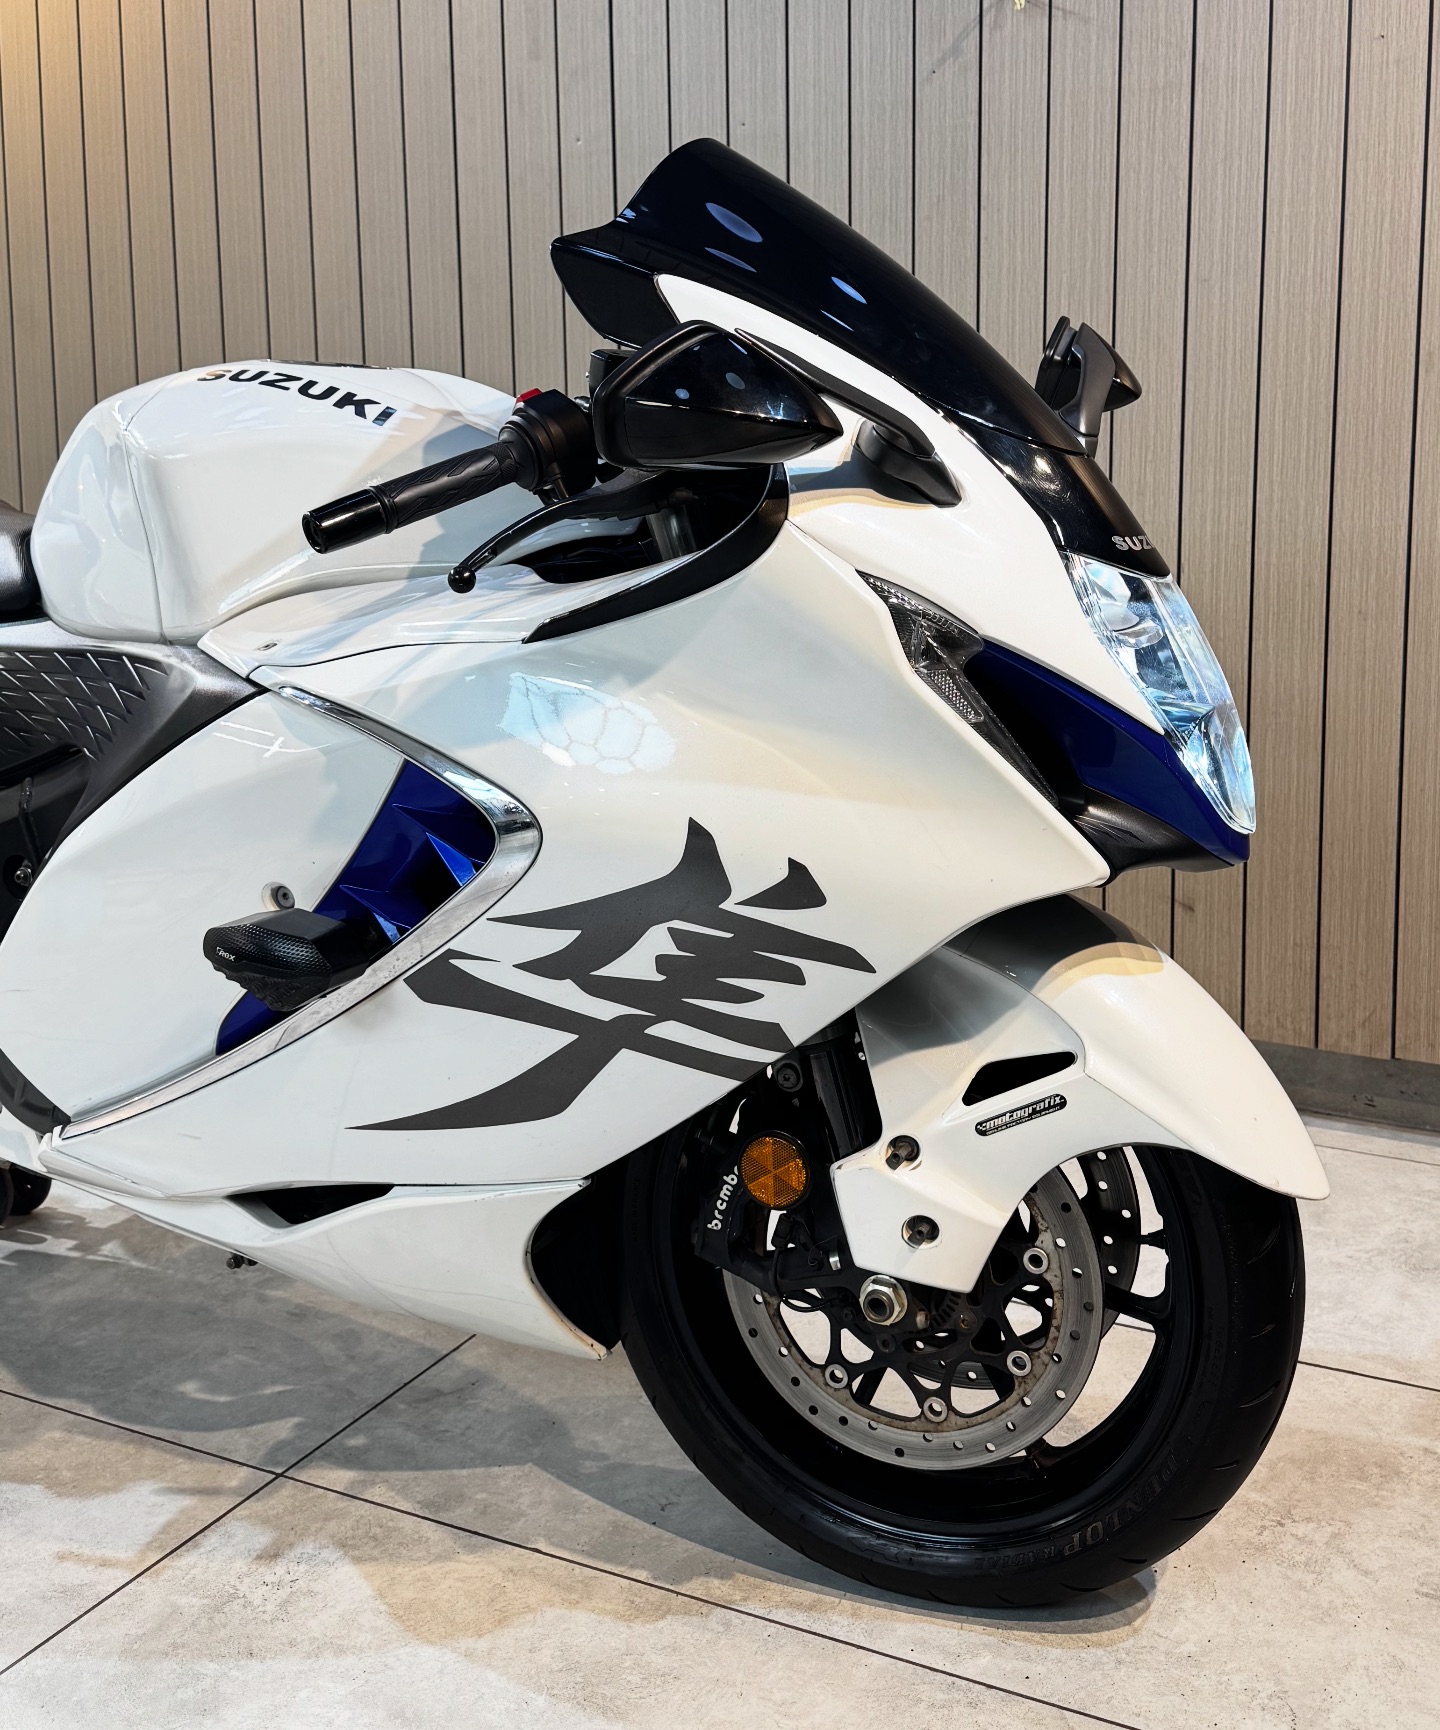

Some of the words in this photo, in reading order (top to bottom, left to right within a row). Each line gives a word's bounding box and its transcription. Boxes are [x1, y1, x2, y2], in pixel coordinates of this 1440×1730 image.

[197, 369, 397, 427] SUZUKI
[1111, 535, 1155, 551] SUZ
[986, 1094, 1062, 1131] motografix
[1062, 1448, 1184, 1557] DUNLOP
